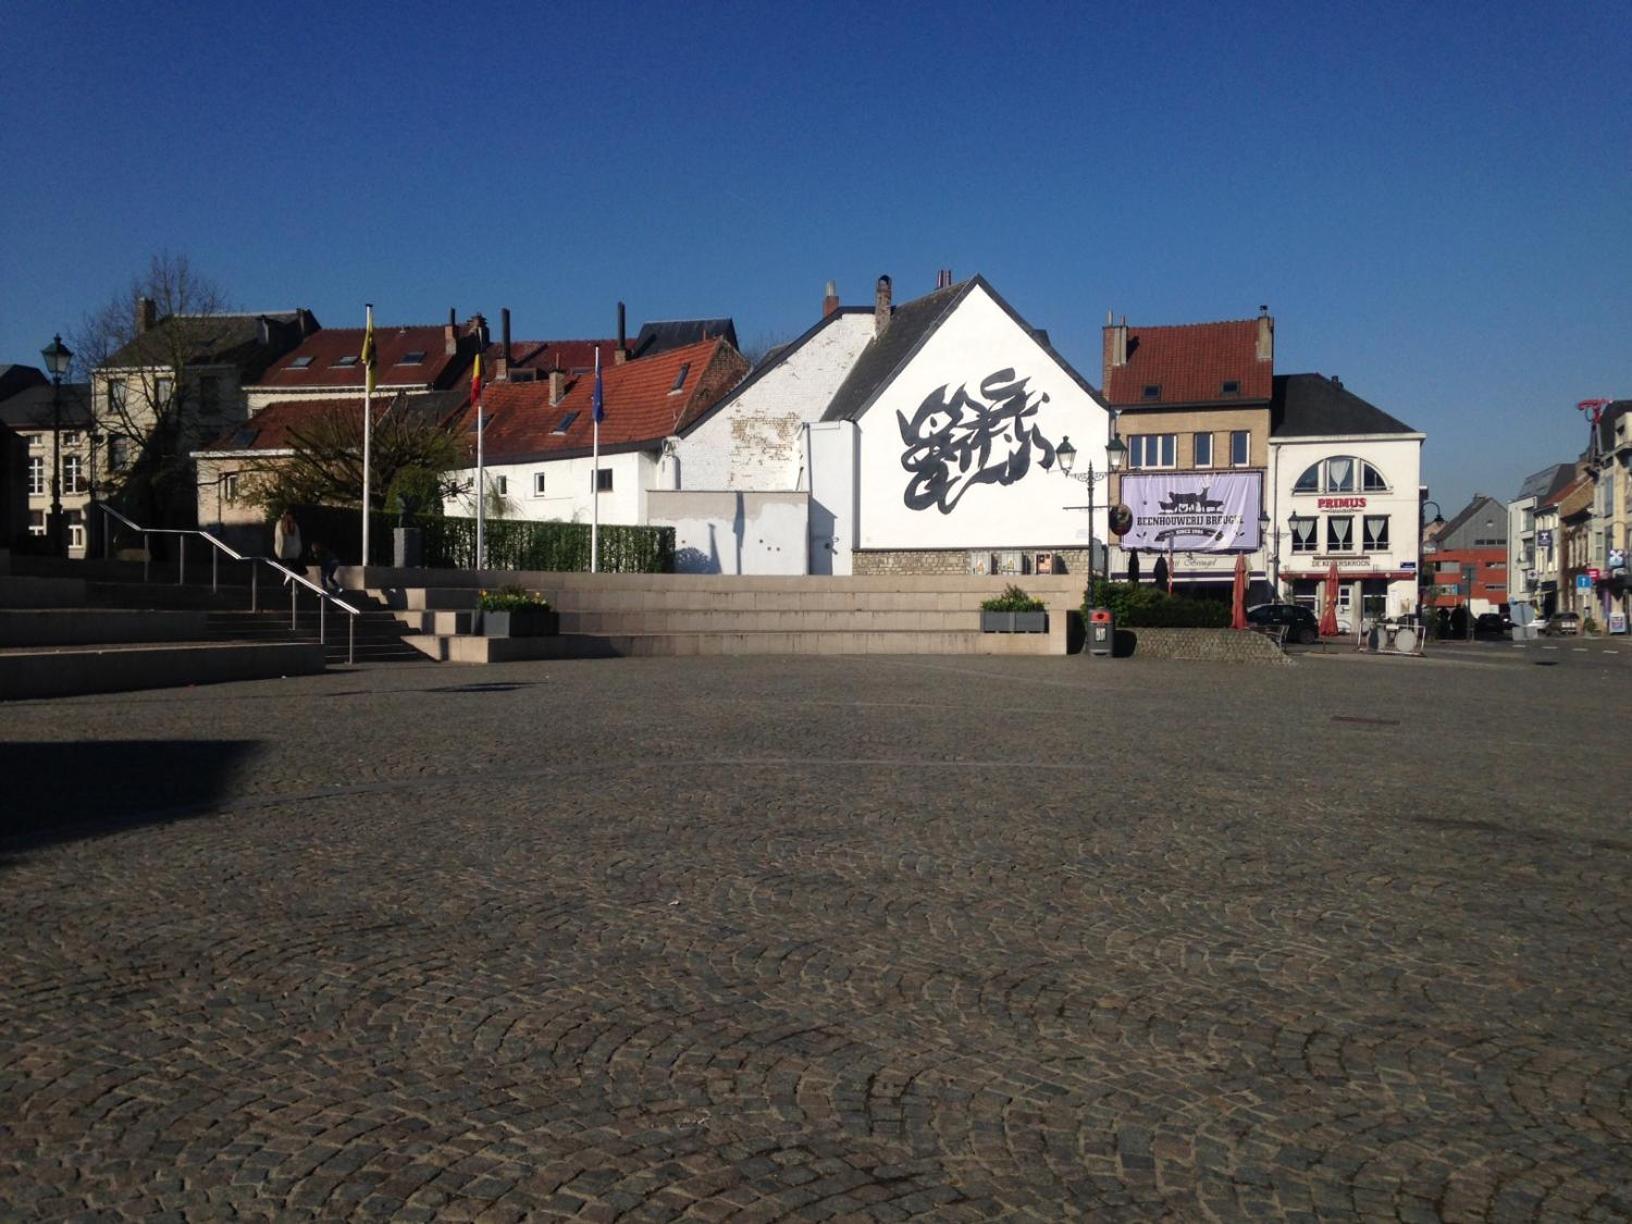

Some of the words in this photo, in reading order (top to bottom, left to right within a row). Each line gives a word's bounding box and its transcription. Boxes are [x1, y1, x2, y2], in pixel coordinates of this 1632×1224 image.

[1318, 497, 1366, 508] PRIMUS
[1137, 516, 1204, 526] BEENHOUWERIJ
[1206, 515, 1244, 526] BREUGL
